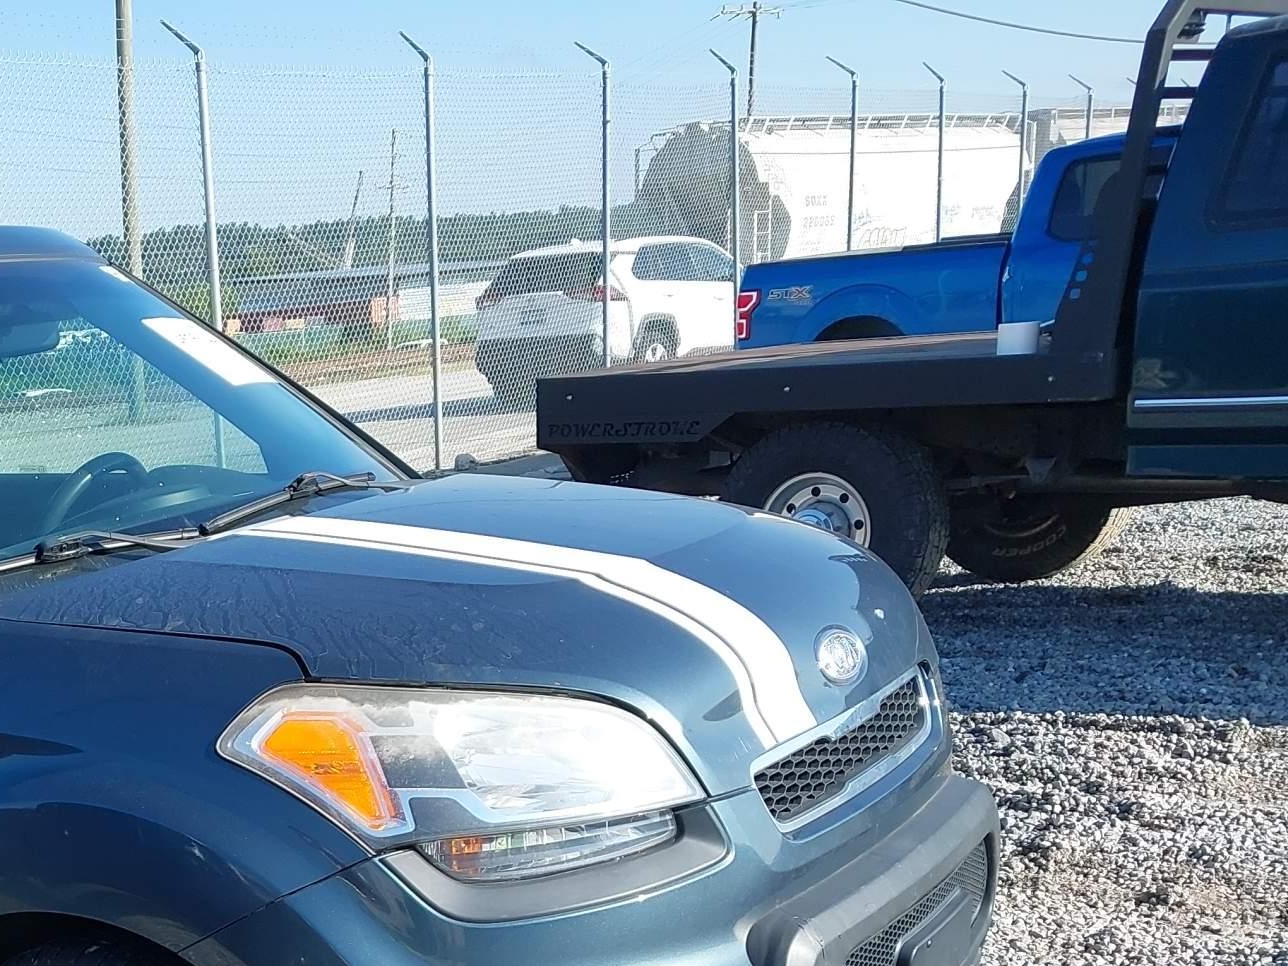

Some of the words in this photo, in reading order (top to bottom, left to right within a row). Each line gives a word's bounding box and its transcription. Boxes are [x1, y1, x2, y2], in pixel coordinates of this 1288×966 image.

[767, 285, 815, 300] STX
[547, 420, 701, 438] POWERSTROKE
[991, 525, 1067, 557] COOPER
